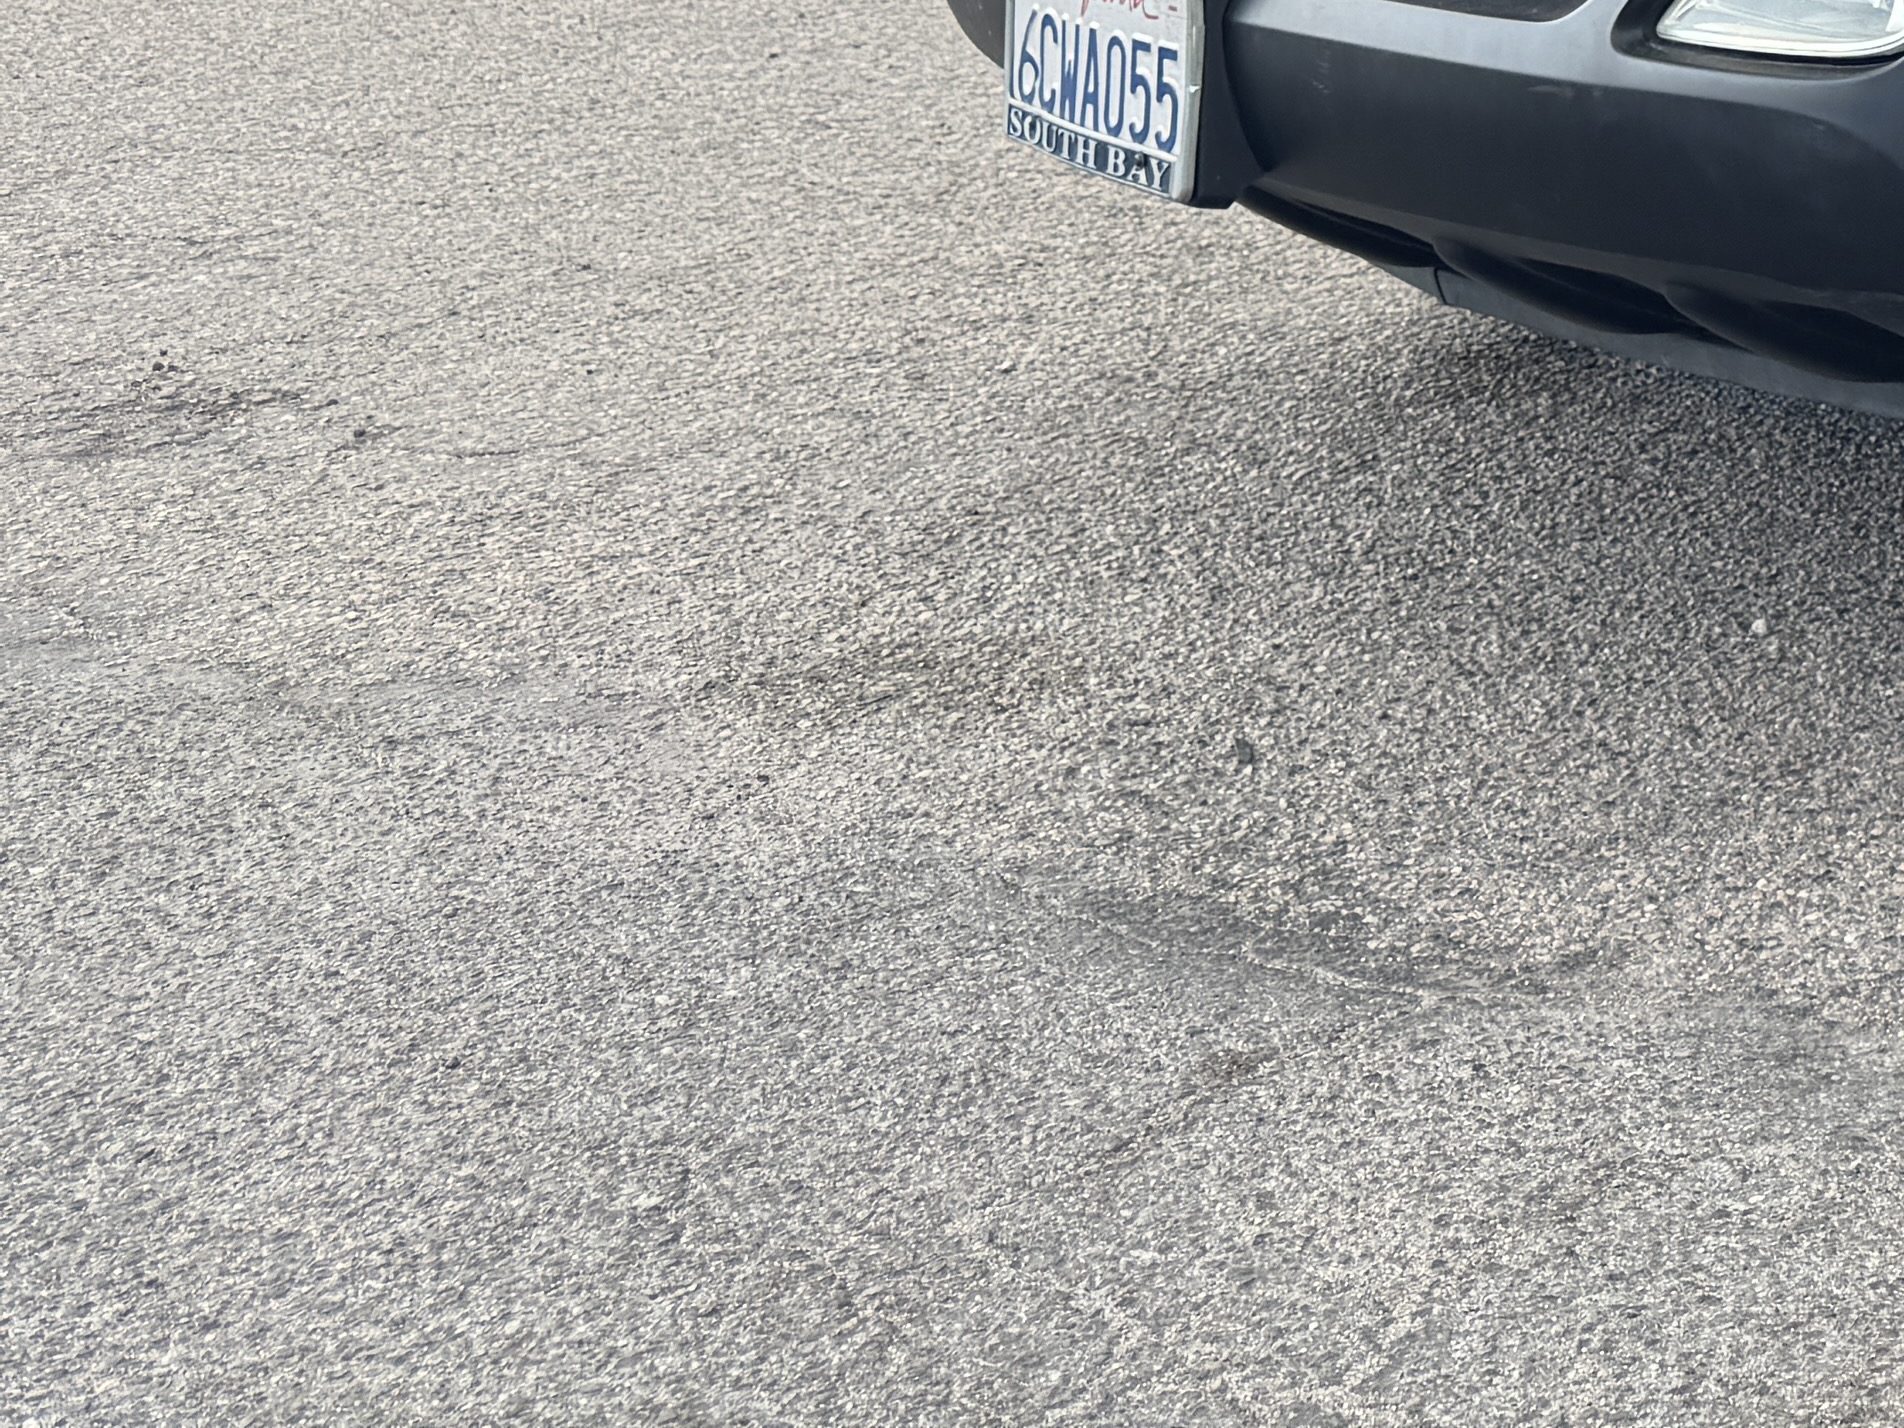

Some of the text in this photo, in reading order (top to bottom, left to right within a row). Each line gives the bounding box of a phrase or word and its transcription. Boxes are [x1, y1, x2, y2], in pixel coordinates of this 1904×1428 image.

[1017, 7, 1180, 155] 6CWA055
[1008, 109, 1171, 190] SOUTH BAY
